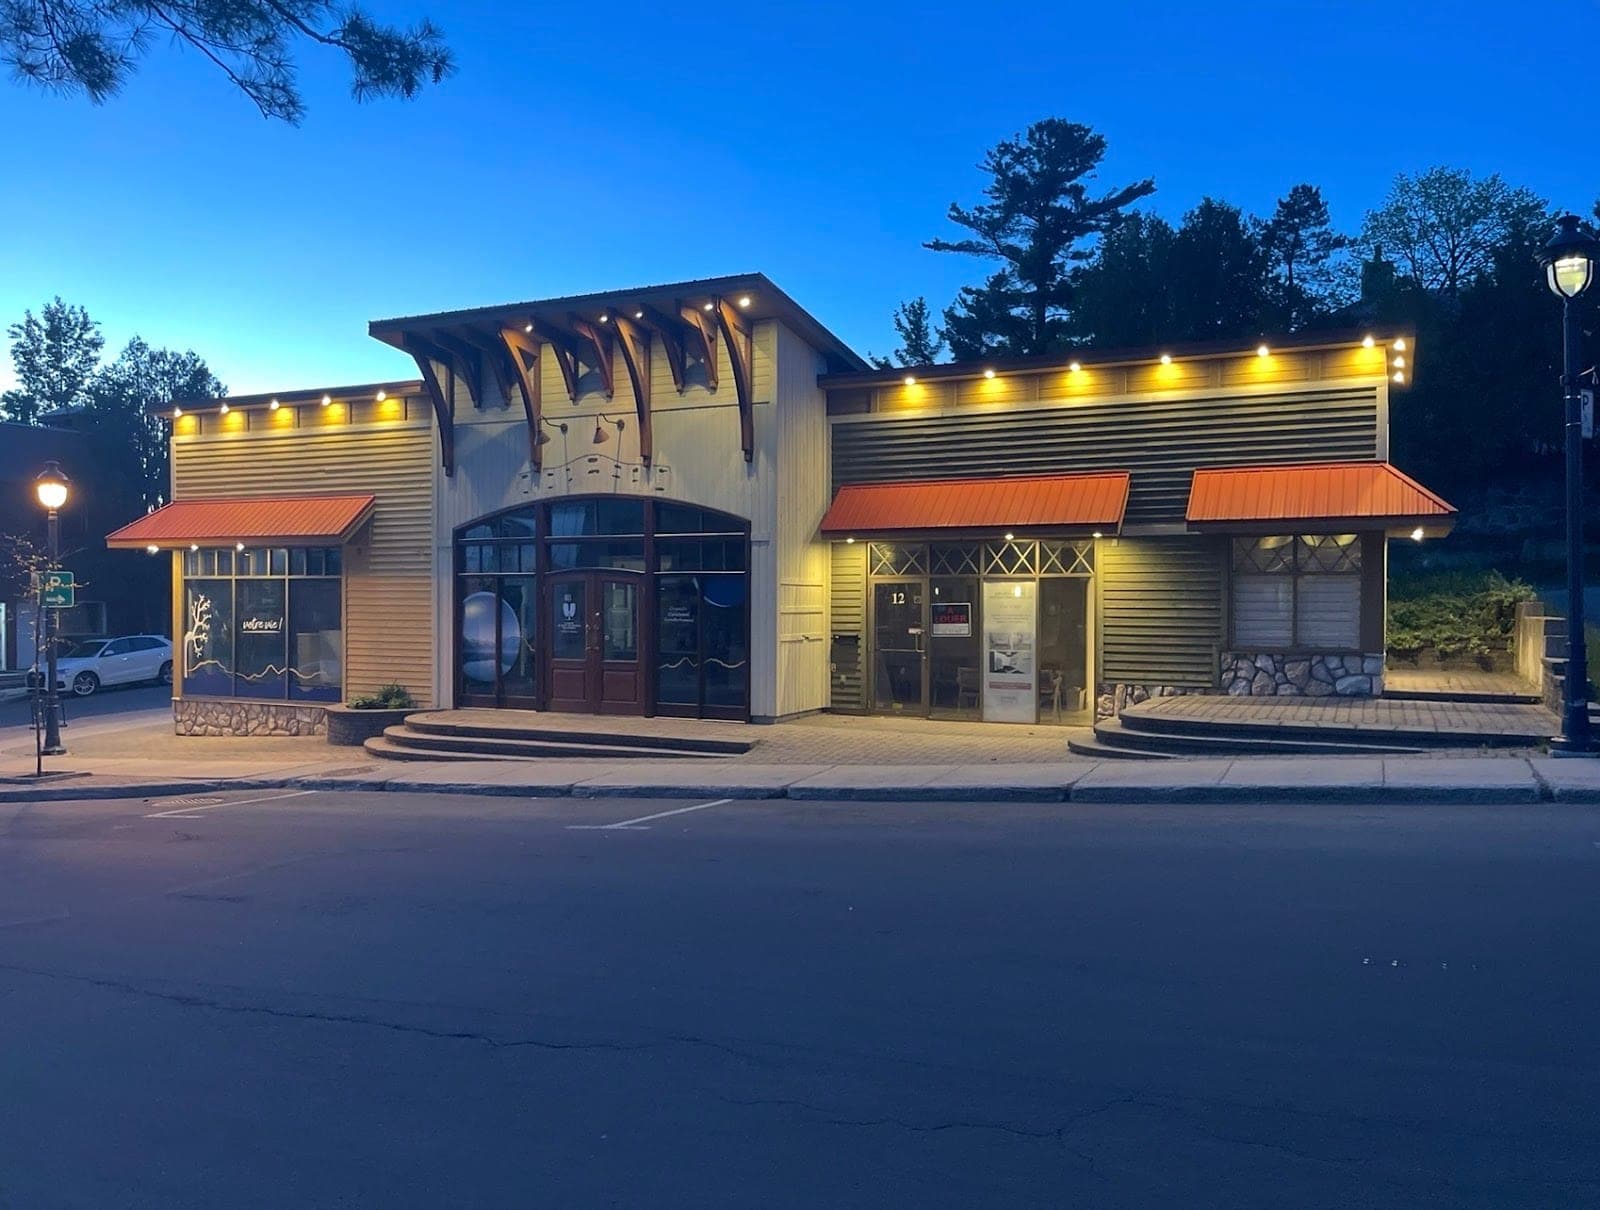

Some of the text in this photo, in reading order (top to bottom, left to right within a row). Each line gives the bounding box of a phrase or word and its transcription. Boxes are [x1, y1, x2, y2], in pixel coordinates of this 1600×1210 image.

[50, 576, 61, 591] P
[891, 592, 905, 604] 12
[242, 617, 264, 630] votre
[935, 614, 967, 623] LOUER
